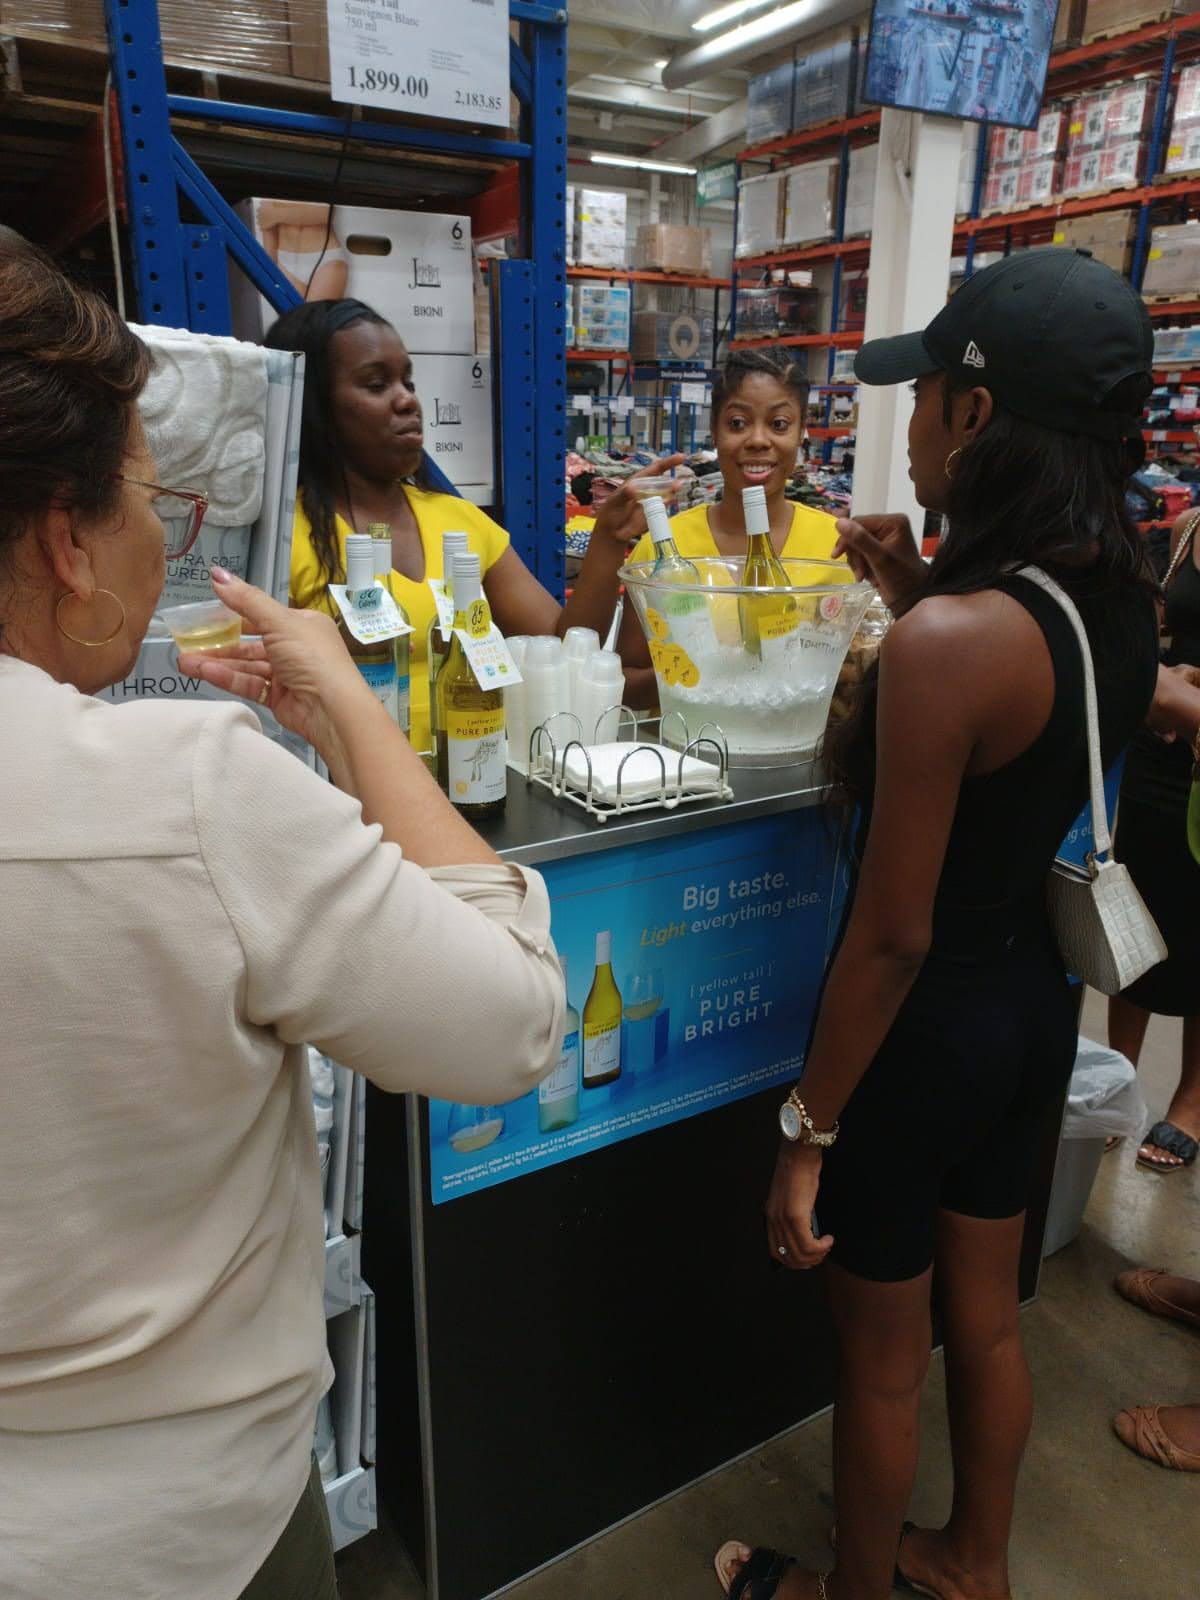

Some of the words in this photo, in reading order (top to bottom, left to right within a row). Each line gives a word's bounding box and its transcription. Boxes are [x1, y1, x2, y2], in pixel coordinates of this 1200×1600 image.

[344, 3, 392, 24] Sauvignon
[394, 12, 420, 27] Blanc
[346, 16, 363, 29] 750
[365, 20, 377, 32] ml
[347, 65, 429, 99] 1,899.00
[455, 90, 502, 111] 2,183.85
[451, 221, 463, 240] 6
[413, 305, 443, 317] BIKINI
[472, 361, 483, 379] 6
[435, 442, 463, 453] BIKINI
[211, 555, 241, 568] SOFT
[111, 677, 200, 697] THROW
[456, 727, 481, 737] PURE
[683, 885, 720, 912] Big
[728, 871, 790, 899] taste.
[640, 921, 687, 948] Light
[690, 901, 783, 933] everything
[786, 890, 822, 909] else.
[699, 975, 739, 996] yellow
[743, 966, 764, 981] tail
[700, 984, 761, 1017] PURE
[684, 1001, 774, 1042] BRIGHT
